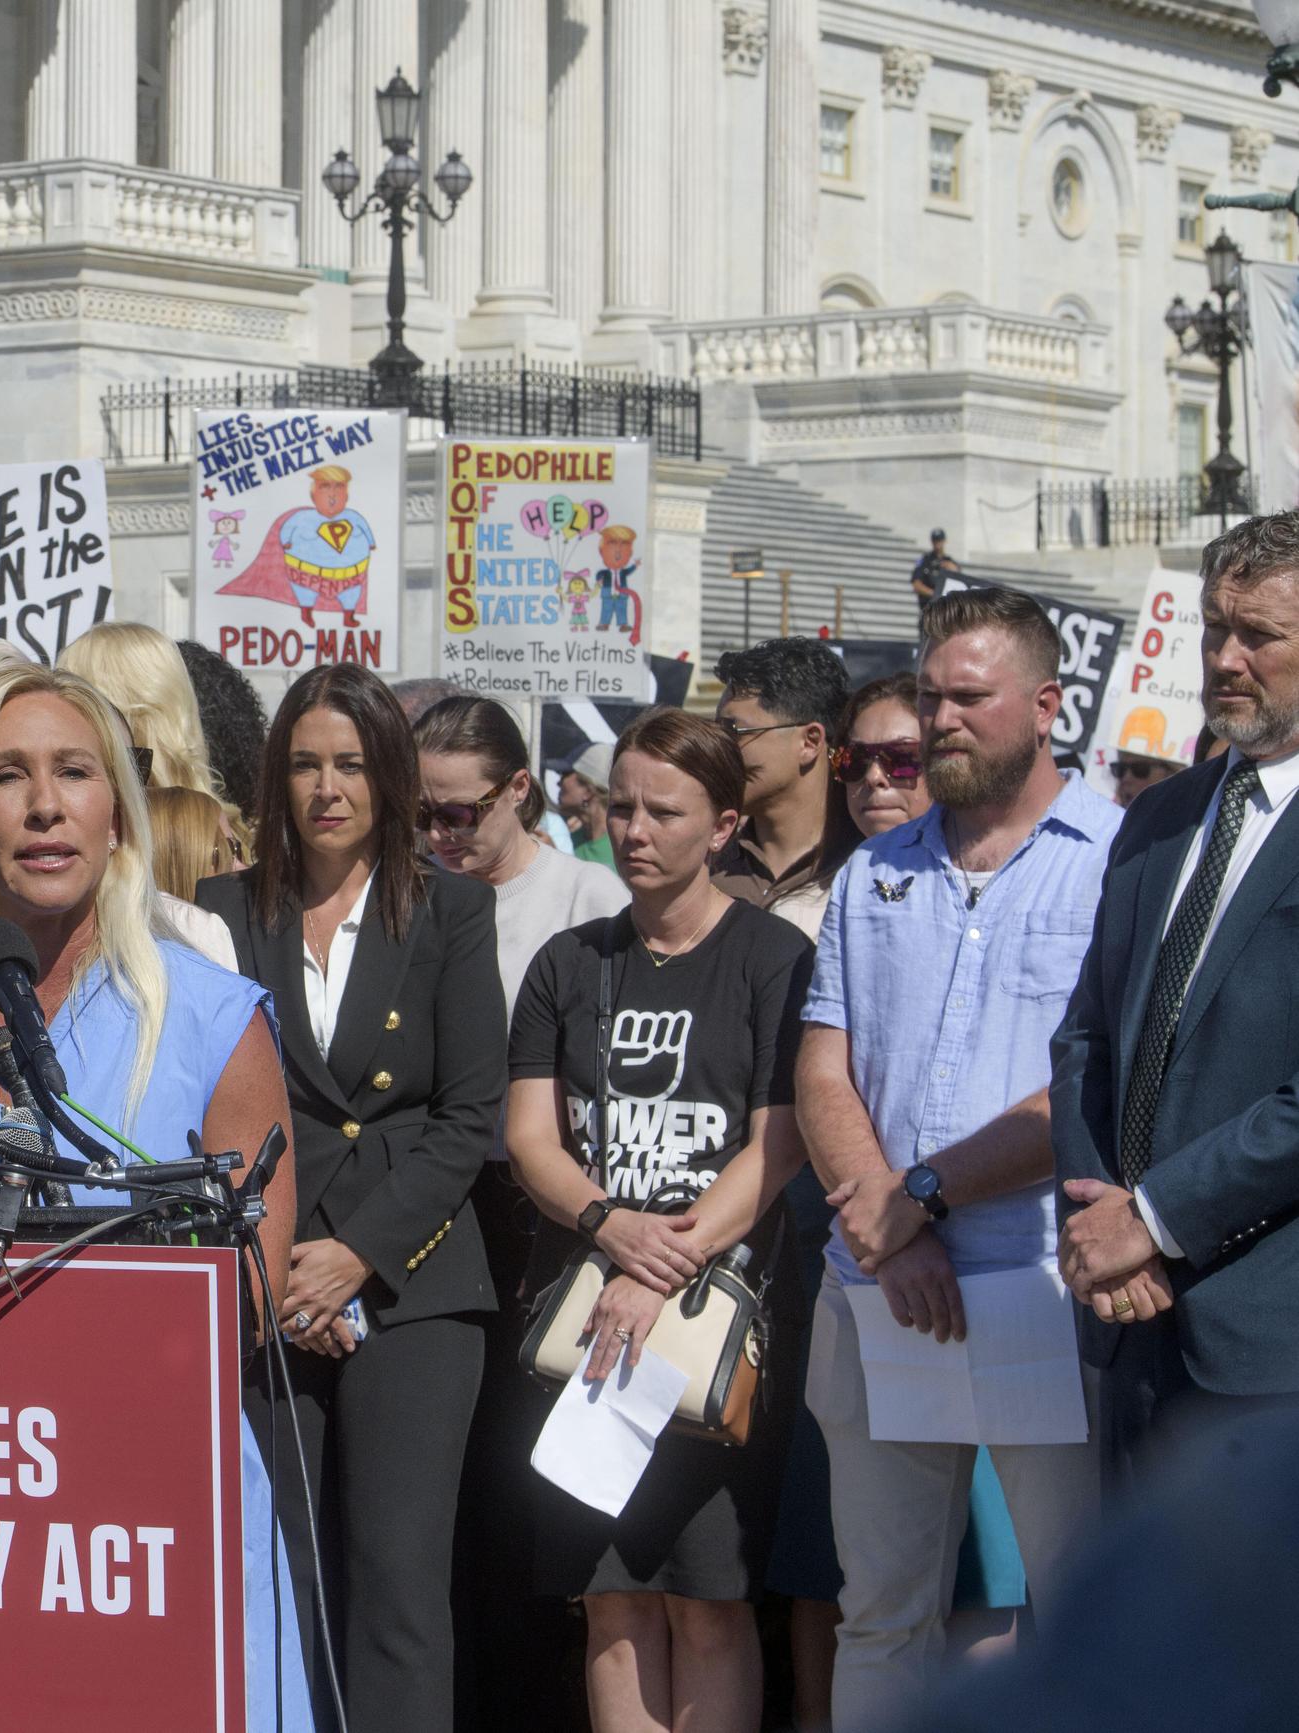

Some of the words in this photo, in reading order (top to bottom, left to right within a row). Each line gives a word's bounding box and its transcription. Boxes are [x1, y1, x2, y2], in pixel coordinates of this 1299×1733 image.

[219, 463, 262, 497] THE
[263, 440, 324, 481] NAZI
[325, 416, 373, 456] WAY
[38, 465, 86, 532] IS
[526, 501, 605, 532] HELP
[40, 528, 105, 579] the
[220, 626, 381, 668] PEDO-MAN
[527, 641, 560, 663] The
[565, 640, 636, 664] Victims
[534, 670, 568, 692] The
[575, 669, 623, 693] Files
[567, 1096, 727, 1151] POWER
[626, 1143, 695, 1171] THE
[40, 1523, 175, 1617] ACT
